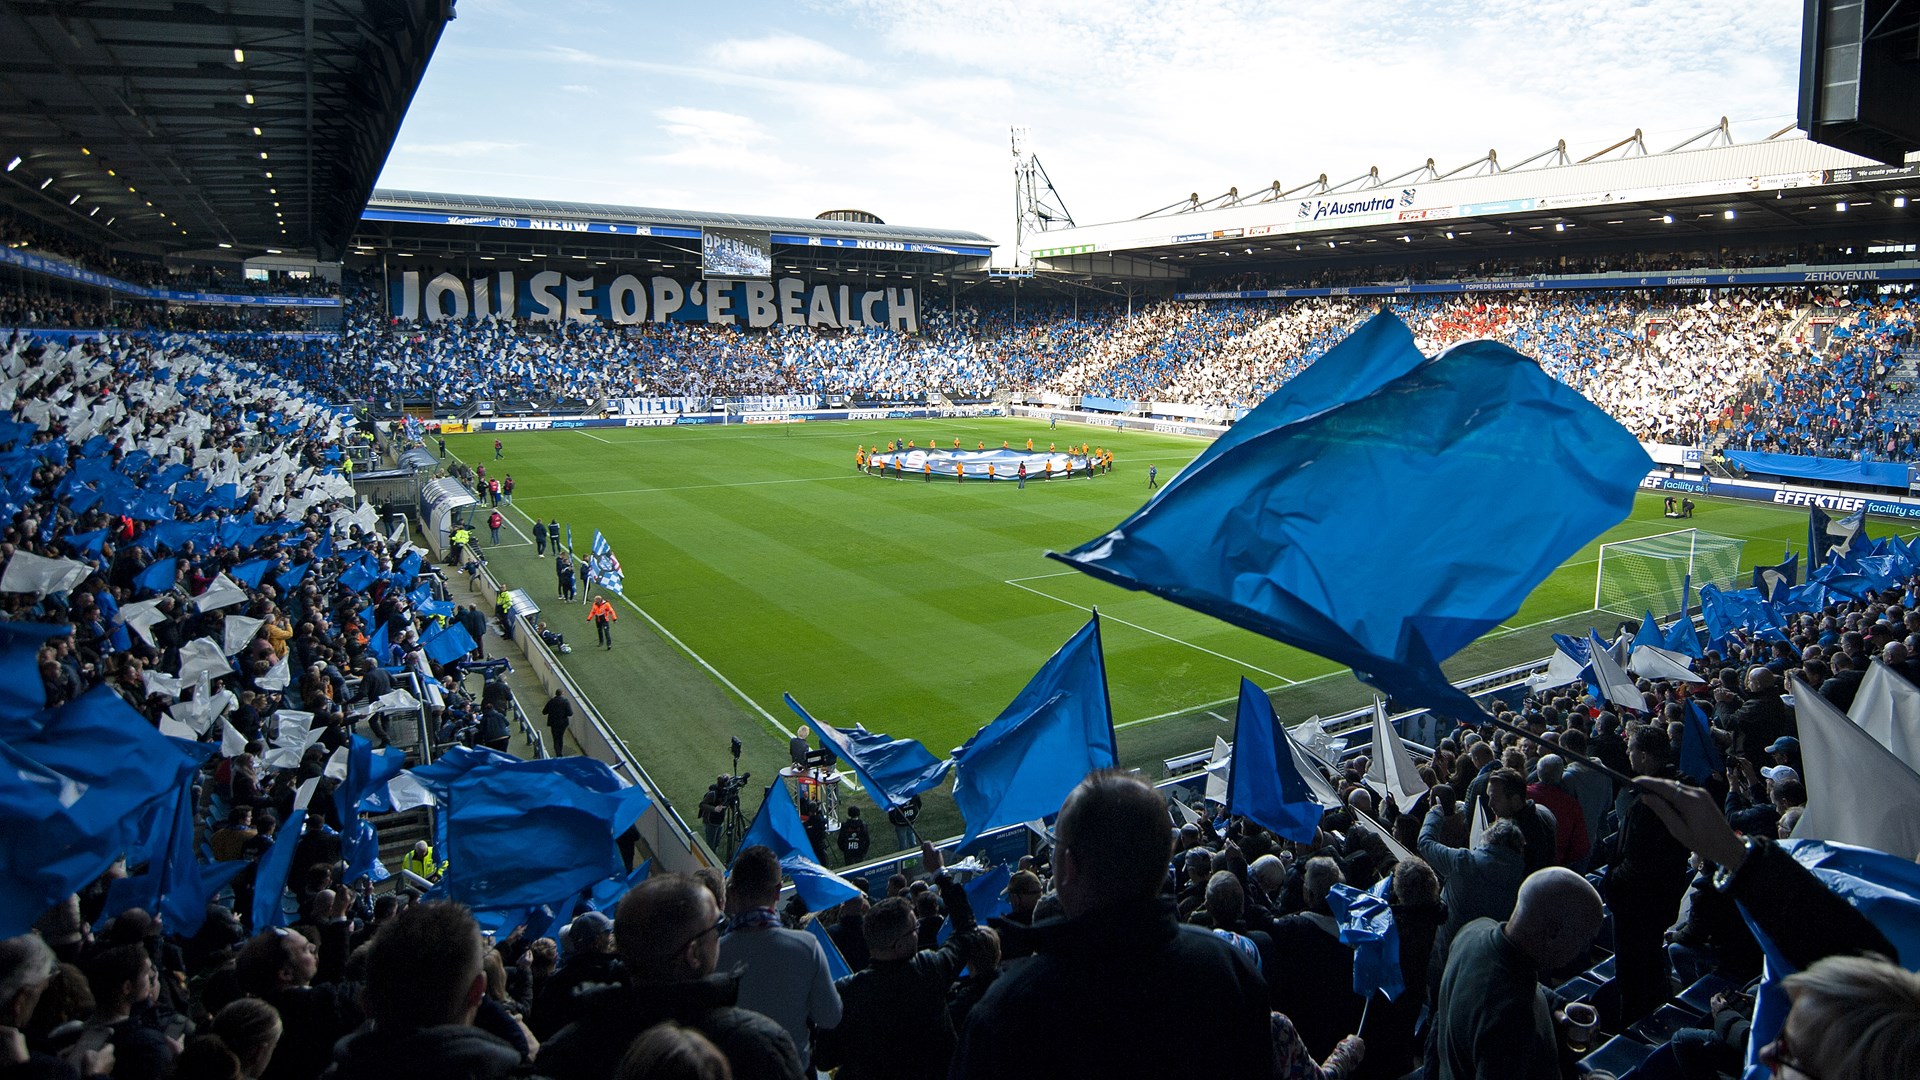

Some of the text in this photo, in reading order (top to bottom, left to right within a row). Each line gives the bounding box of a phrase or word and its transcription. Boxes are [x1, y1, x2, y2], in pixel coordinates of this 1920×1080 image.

[1330, 198, 1395, 216] Ausnutria
[530, 219, 590, 232] NIEUW
[732, 239, 762, 259] BEALCH
[856, 240, 904, 251] NOORD
[1667, 276, 1707, 285] Bordbusters
[1804, 271, 1880, 281] ZETHOVEN.NL
[529, 270, 598, 324] SE
[745, 276, 919, 333] BEALCH
[495, 421, 552, 431] EFFEKTIEF
[552, 420, 575, 429] facility
[625, 418, 676, 427] EFFEKTIEF
[676, 418, 697, 426] facility
[1086, 417, 1113, 426] EFFEKTIEF
[1154, 424, 1186, 433] EFFEKTIEF
[1663, 480, 1694, 492] facility
[1773, 490, 1866, 511] EFFEKTIEF
[1867, 503, 1907, 517] facility
[848, 841, 859, 849] HB
